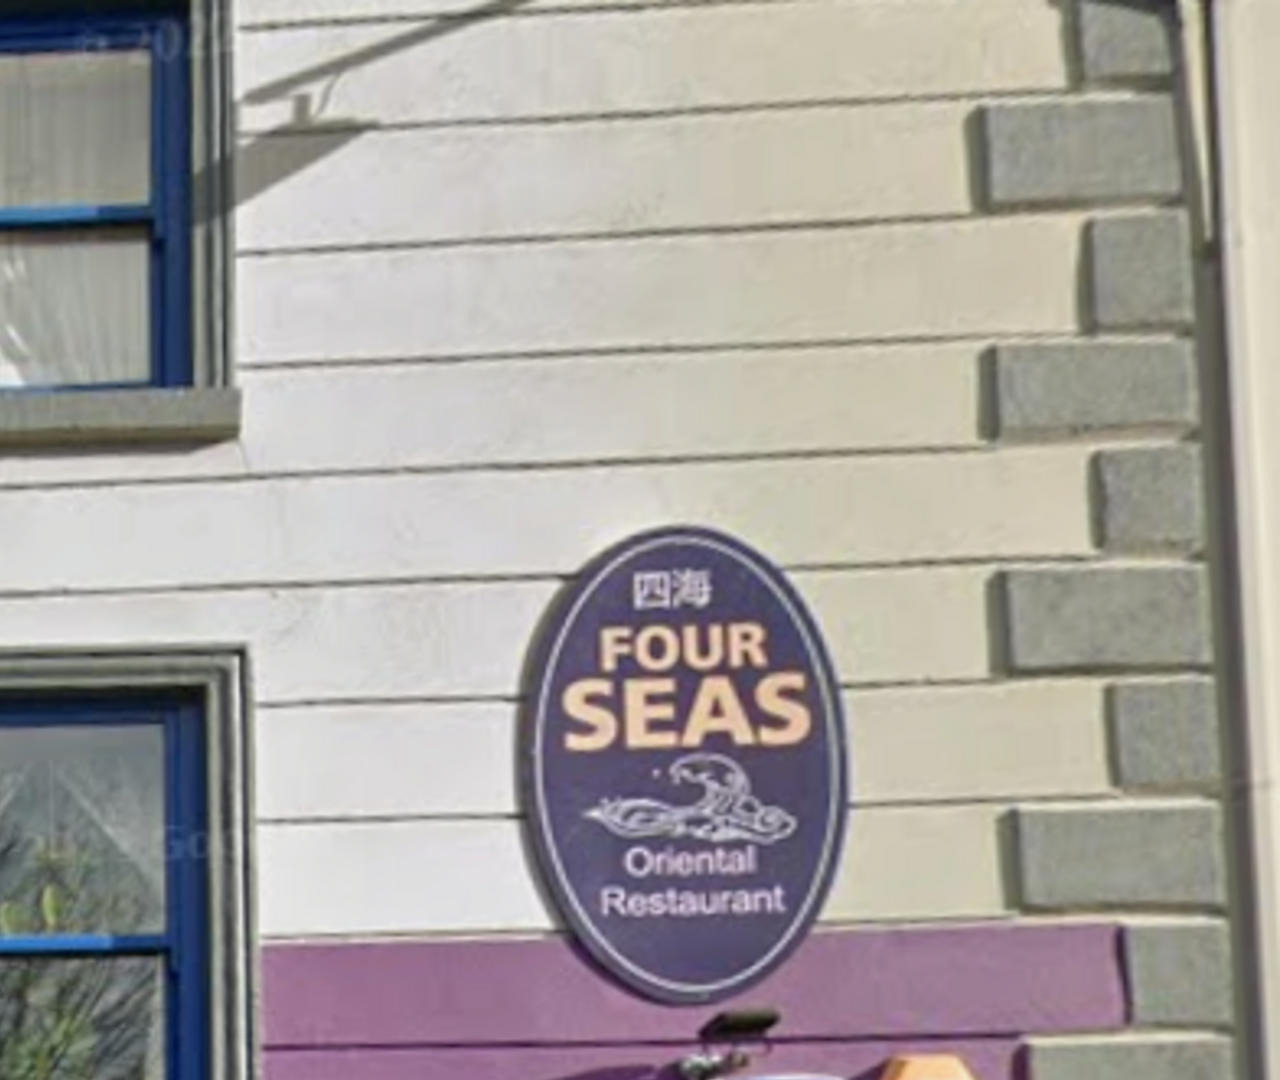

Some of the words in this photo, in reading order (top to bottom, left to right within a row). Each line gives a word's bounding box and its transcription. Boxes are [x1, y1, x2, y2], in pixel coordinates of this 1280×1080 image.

[600, 622, 769, 672] FOUR
[561, 671, 814, 752] SEAS
[624, 845, 758, 877] Oriental
[601, 885, 787, 918] Restaurant
